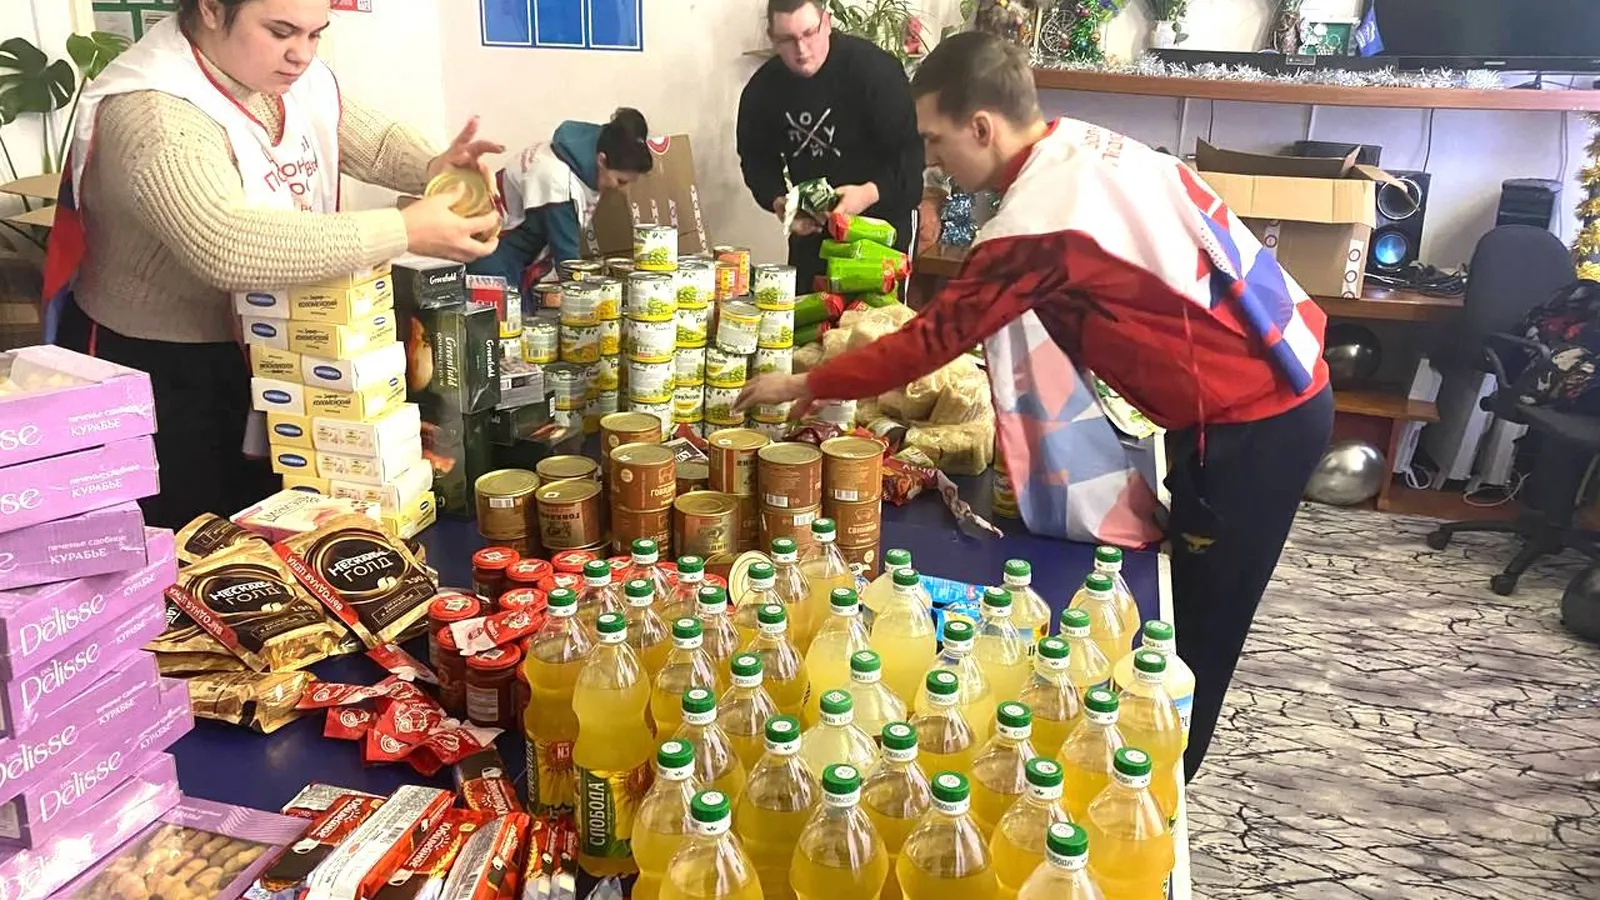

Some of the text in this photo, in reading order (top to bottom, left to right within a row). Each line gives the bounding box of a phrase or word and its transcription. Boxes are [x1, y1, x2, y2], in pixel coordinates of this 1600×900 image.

[429, 272, 457, 285] Greenfield
[445, 337, 458, 388] Greenfield
[485, 339, 496, 378] Greenfield
[71, 418, 121, 437] КУРАБЬЕ
[71, 479, 122, 498] КУРАБЬЕ
[50, 548, 108, 565] КУРАБЬЕ
[287, 554, 306, 575] ЦЕНА
[343, 556, 393, 582] ГОЛД
[225, 586, 282, 606] ГОЛД
[304, 573, 345, 611] ВЫГОДНАЯ
[20, 594, 107, 657] Delisse
[20, 643, 99, 712] Delisse
[40, 751, 122, 823] Delisse
[588, 781, 606, 846] СЛОБОДА
